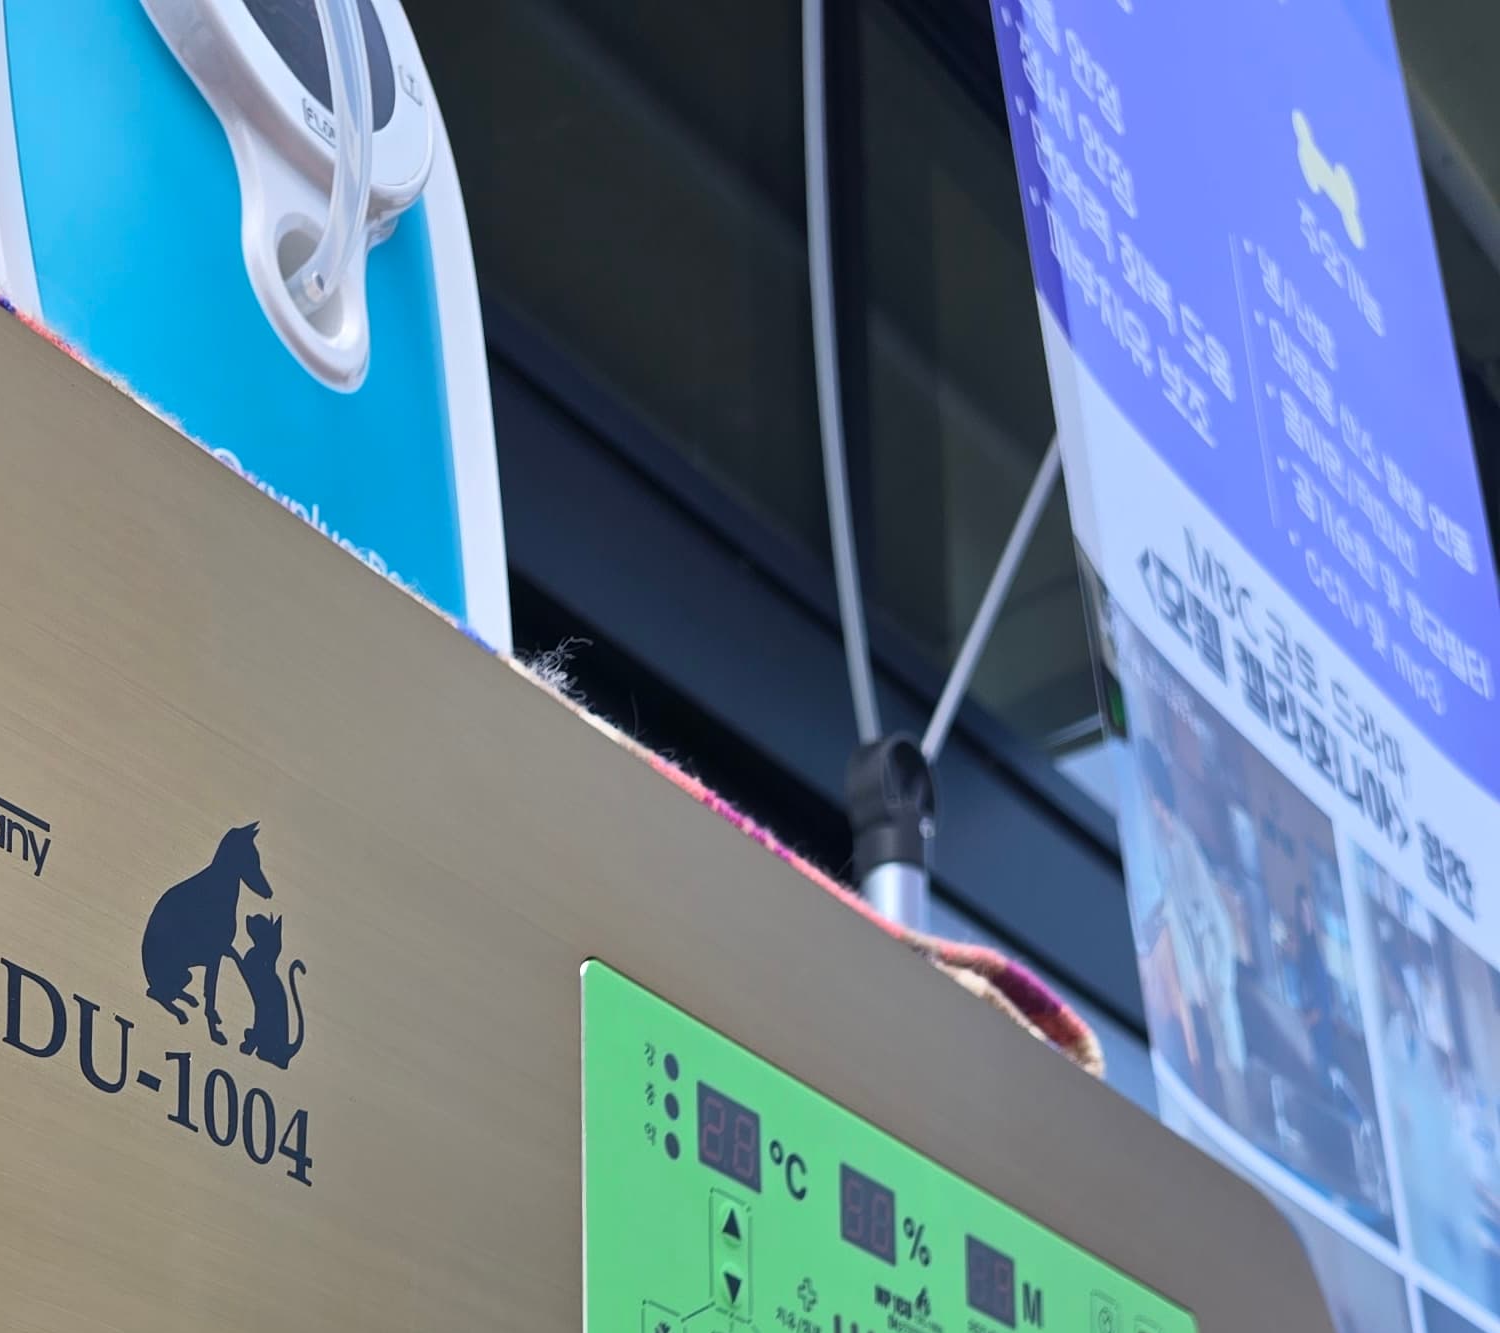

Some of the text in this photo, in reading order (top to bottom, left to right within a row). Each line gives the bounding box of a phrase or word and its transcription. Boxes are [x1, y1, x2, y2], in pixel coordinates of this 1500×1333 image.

[1031, 111, 1236, 403] 면역력 회복 도움
[1184, 525, 1408, 785] MBC 금토 드라마
[0, 957, 314, 1188] DU-1004
[902, 1216, 932, 1268] %
[1022, 1281, 1044, 1330] M
